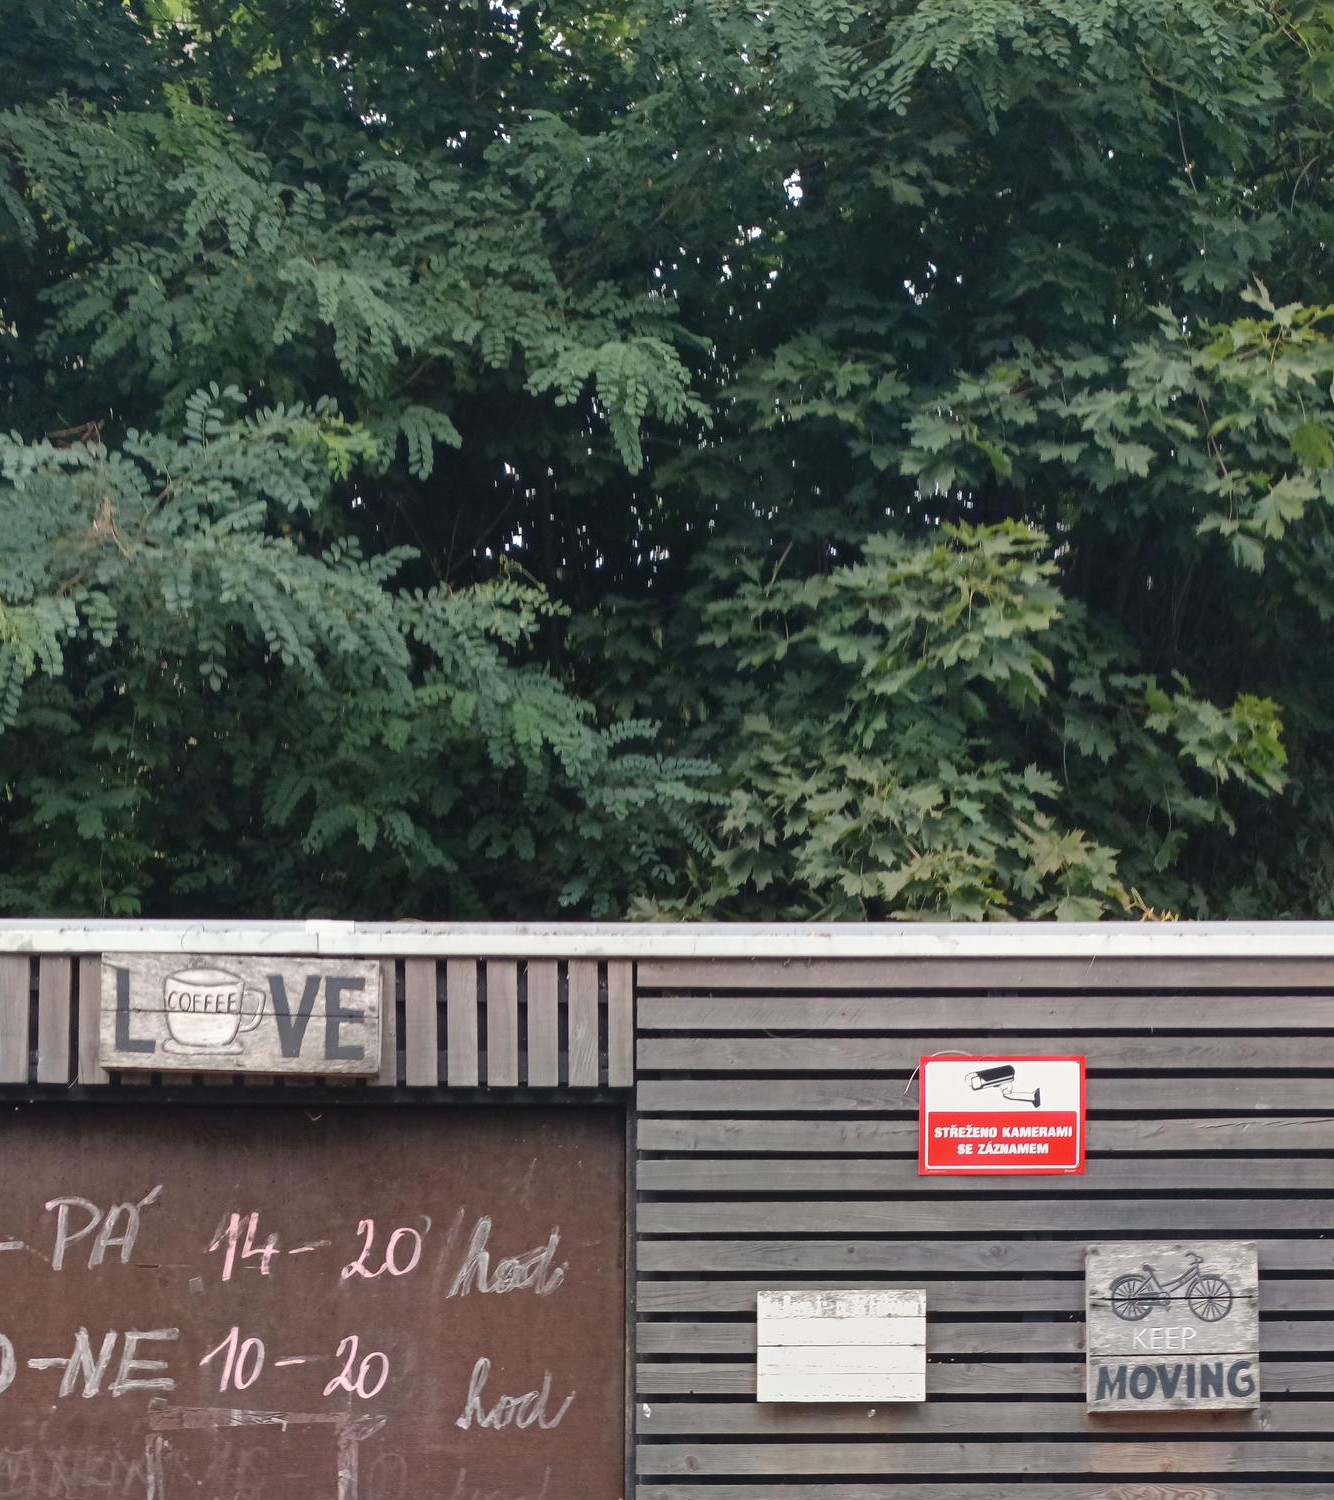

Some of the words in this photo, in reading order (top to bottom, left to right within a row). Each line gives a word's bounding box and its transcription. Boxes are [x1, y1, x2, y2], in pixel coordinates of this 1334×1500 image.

[167, 990, 237, 1014] COFFEE
[934, 1124, 998, 1139] STŘEŽENO
[1002, 1126, 1073, 1138] KAMERAMI
[957, 1143, 973, 1155] SE
[977, 1141, 1049, 1155] ZÁZNAMEM
[1131, 1327, 1197, 1352] KEEP
[455, 1356, 577, 1430] hod
[1095, 1360, 1257, 1402] MOVING
